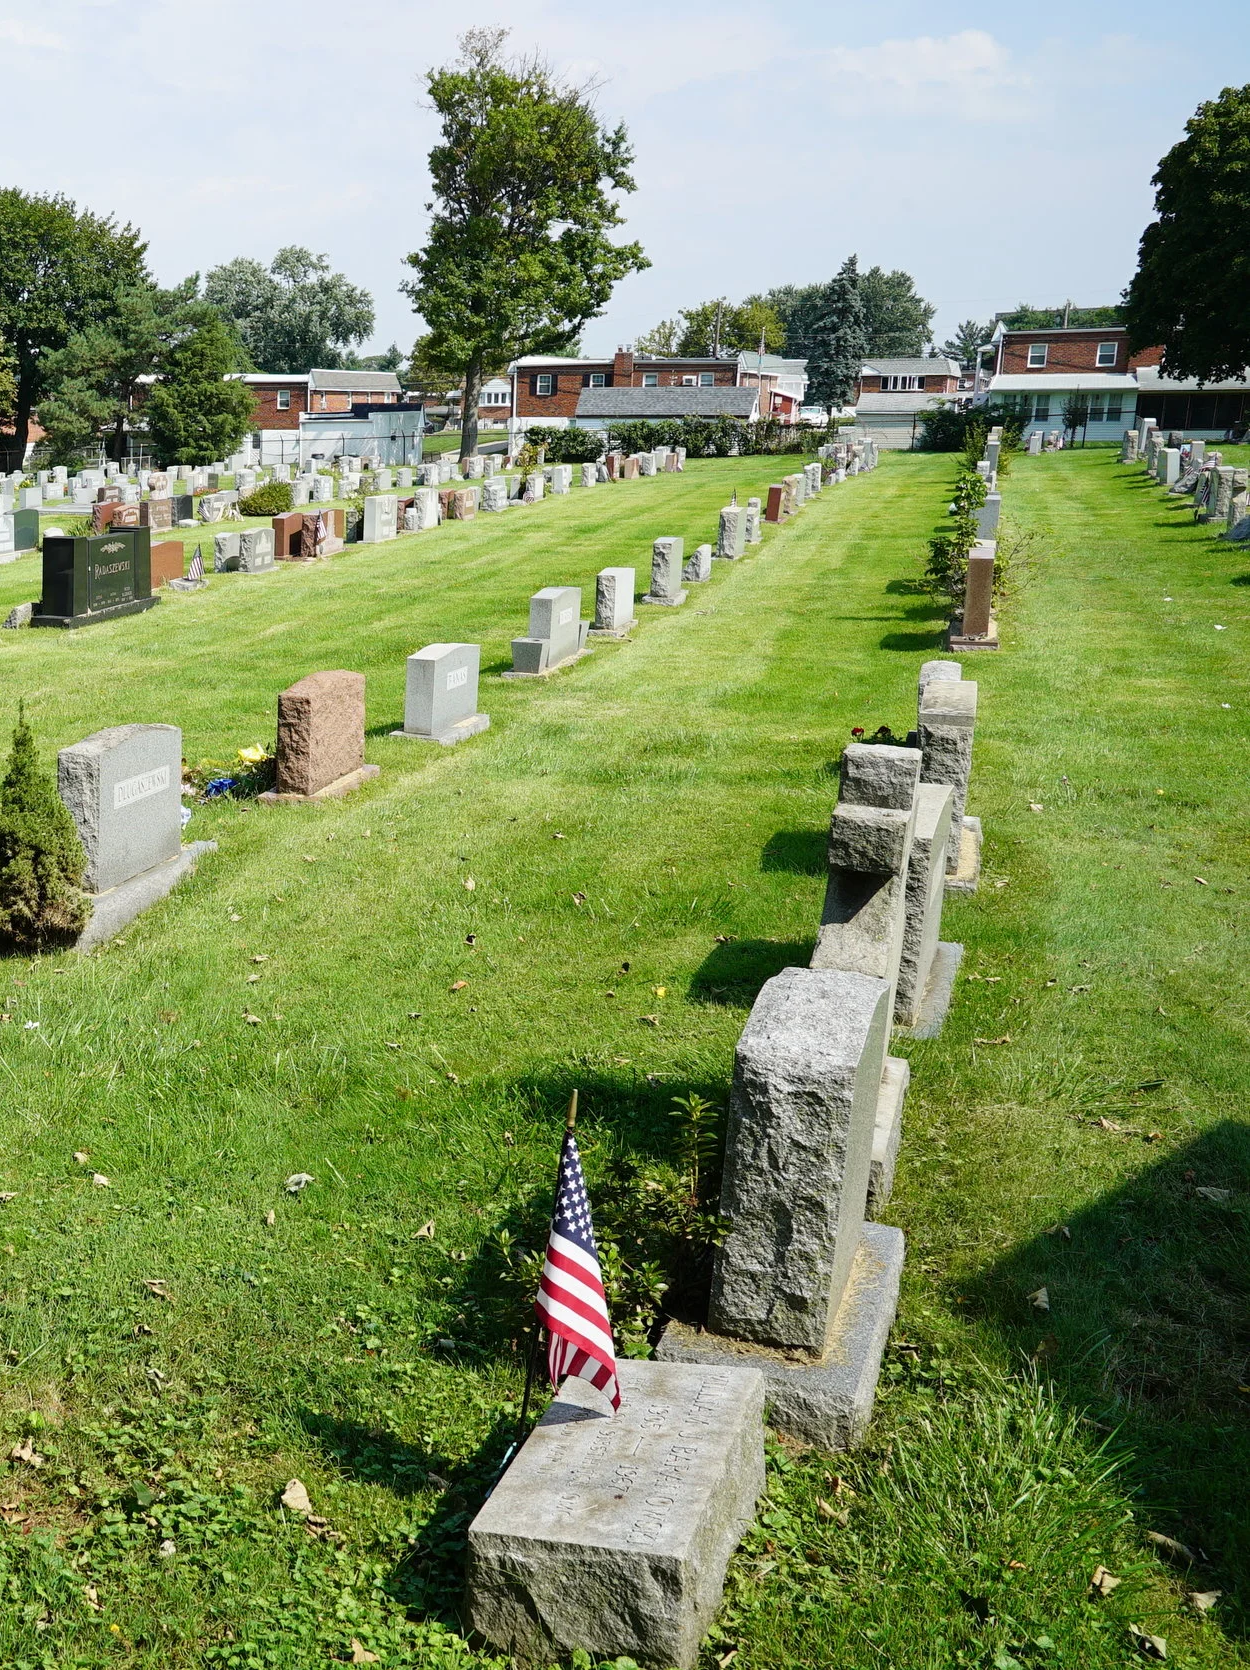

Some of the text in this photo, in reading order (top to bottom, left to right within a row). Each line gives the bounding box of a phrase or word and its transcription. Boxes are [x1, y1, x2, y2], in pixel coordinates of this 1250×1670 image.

[94, 560, 130, 580] RADASZEWSKI
[682, 1369, 733, 1425] WILLIAM
[637, 1403, 672, 1430] 1905
[604, 1463, 641, 1493] 1967
[624, 1444, 699, 1548] BARANOWSKI
